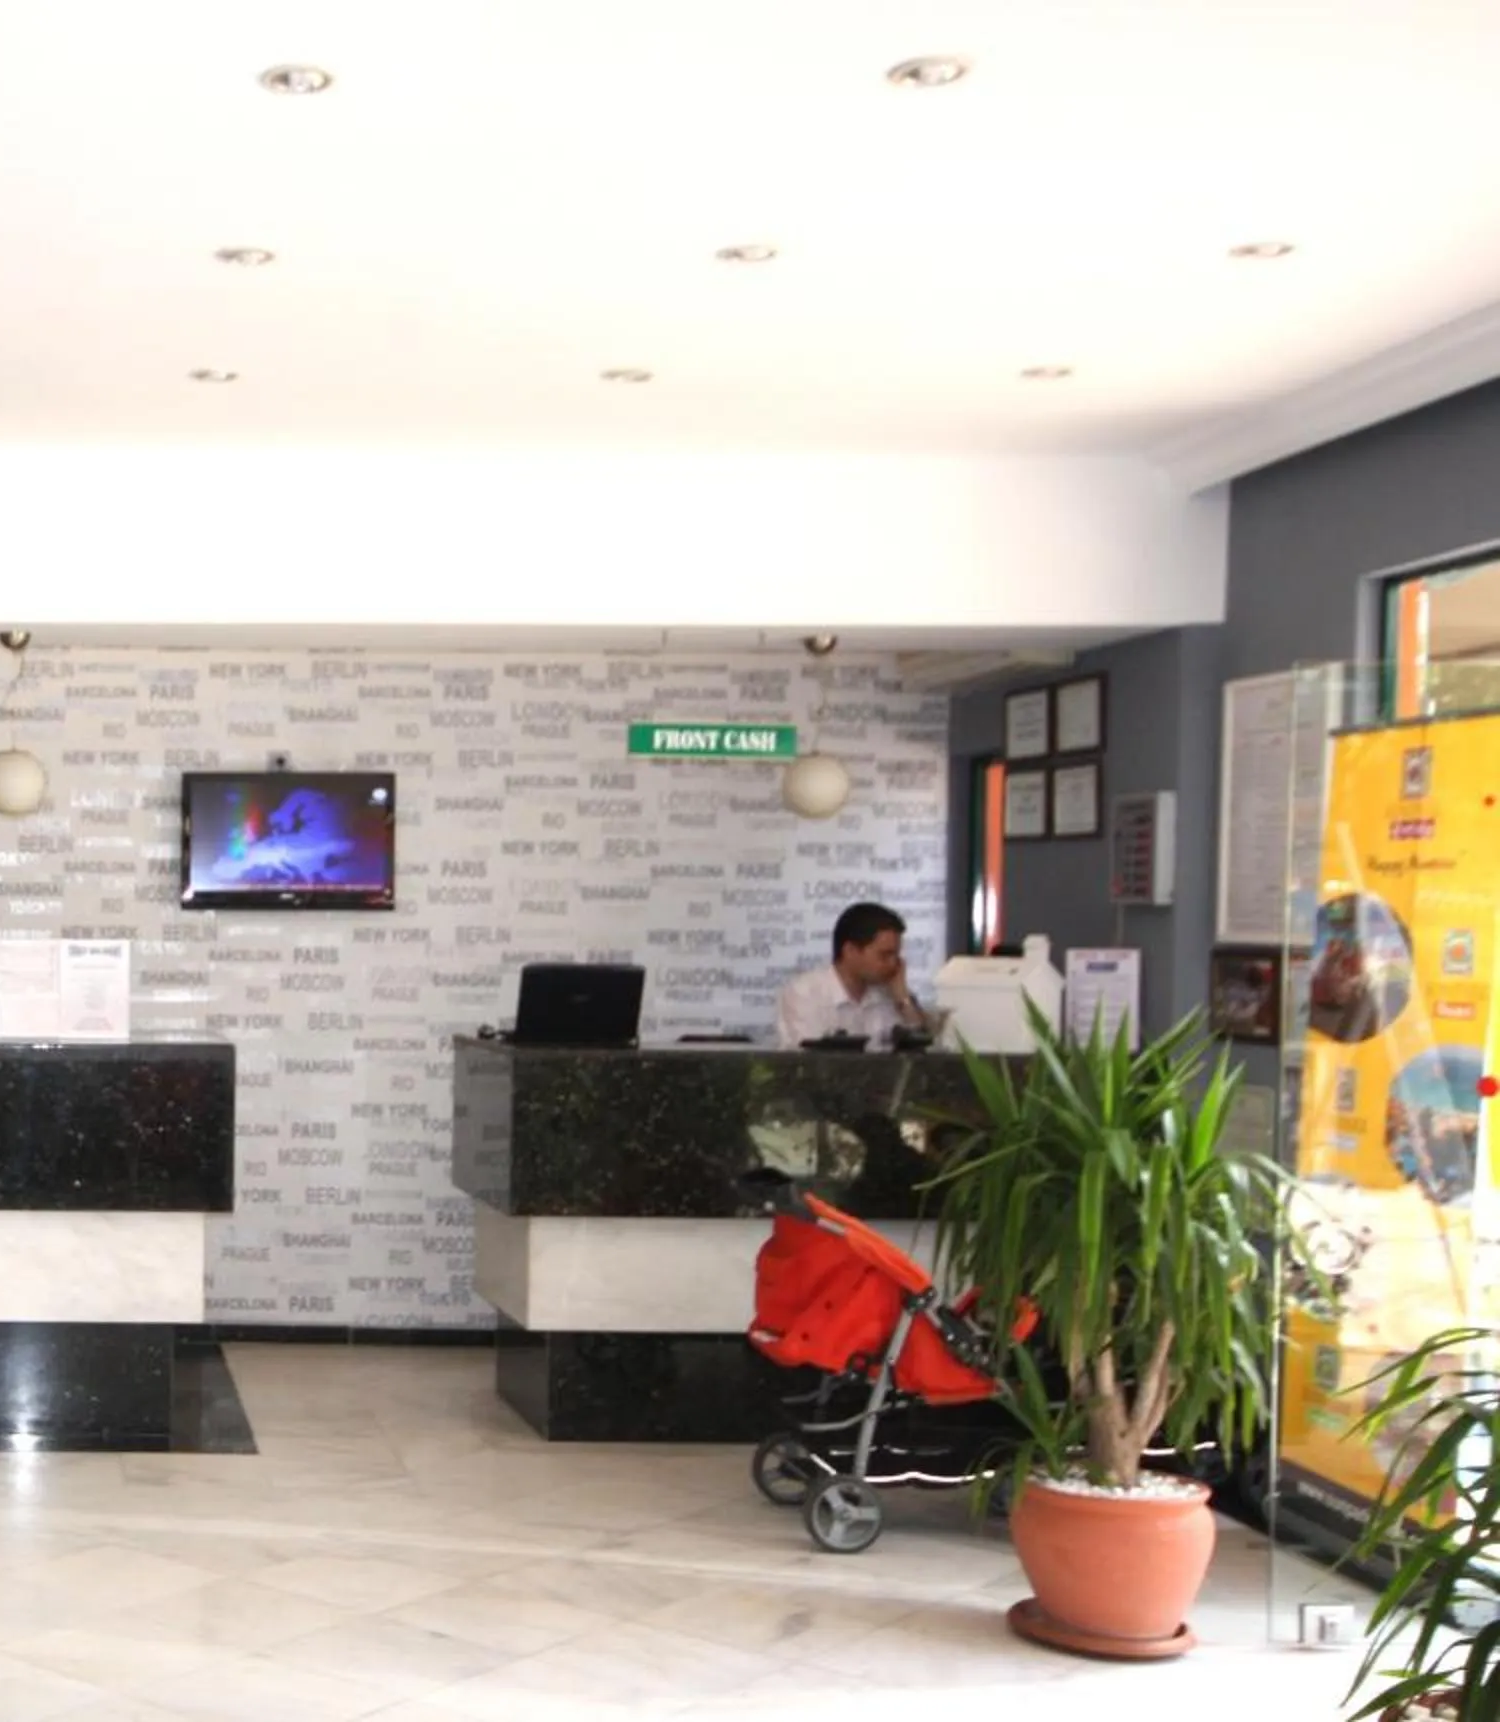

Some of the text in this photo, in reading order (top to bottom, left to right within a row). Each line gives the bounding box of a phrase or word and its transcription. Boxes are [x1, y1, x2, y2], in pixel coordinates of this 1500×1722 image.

[151, 684, 195, 701] PARIS
[444, 685, 489, 702] PARIS
[653, 729, 777, 752] FRONT CASH
[798, 842, 830, 857] NEW
[869, 857, 921, 872] TOKYO
[718, 945, 770, 959] TOKYO
[290, 1297, 334, 1313] PARIS
